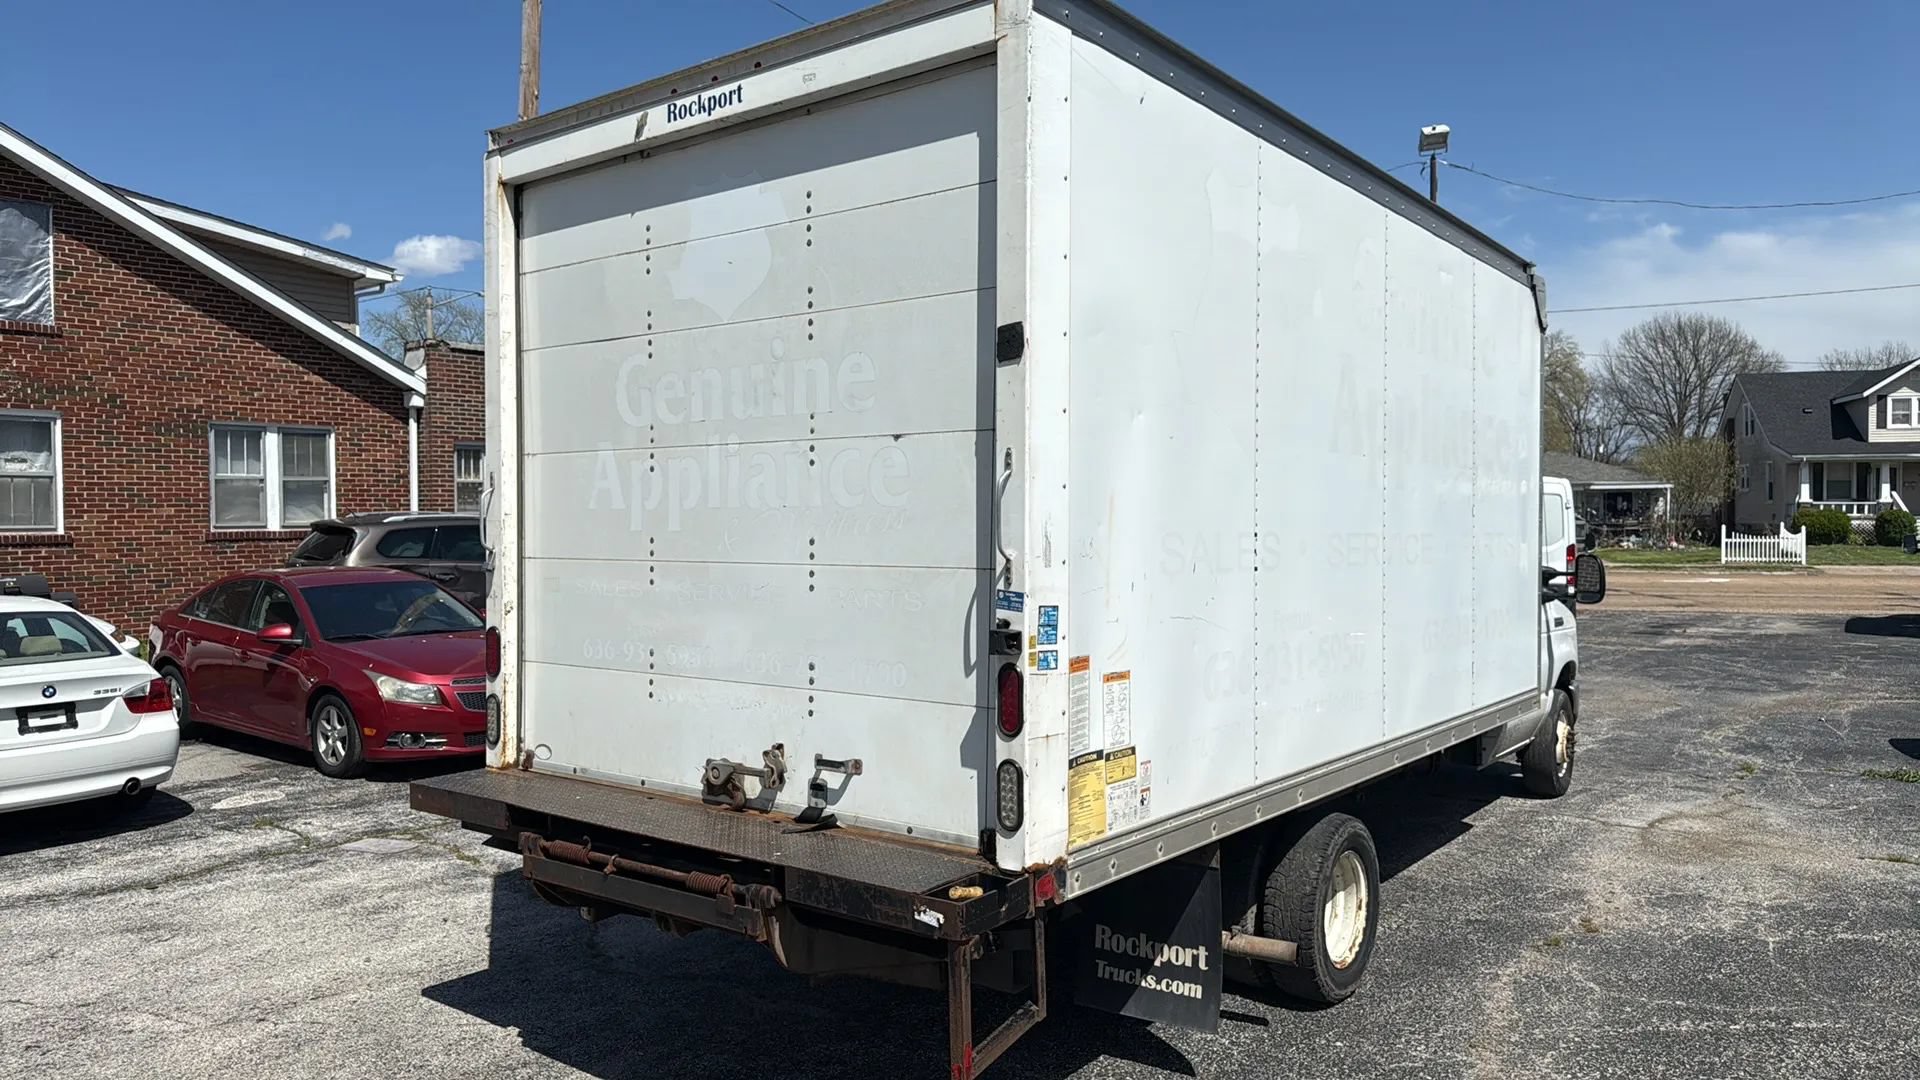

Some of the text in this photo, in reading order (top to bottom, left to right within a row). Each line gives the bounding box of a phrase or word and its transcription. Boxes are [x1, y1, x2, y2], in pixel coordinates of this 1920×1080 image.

[667, 83, 743, 124] Rockport
[615, 336, 878, 427] Genuine
[588, 432, 912, 532] Appliance
[1159, 530, 1281, 576] SALES
[1076, 753, 1098, 765] CAUTION
[1114, 748, 1133, 760] CAUTION
[1094, 924, 1208, 971] Rockport
[1095, 960, 1203, 999] Trucks.com
